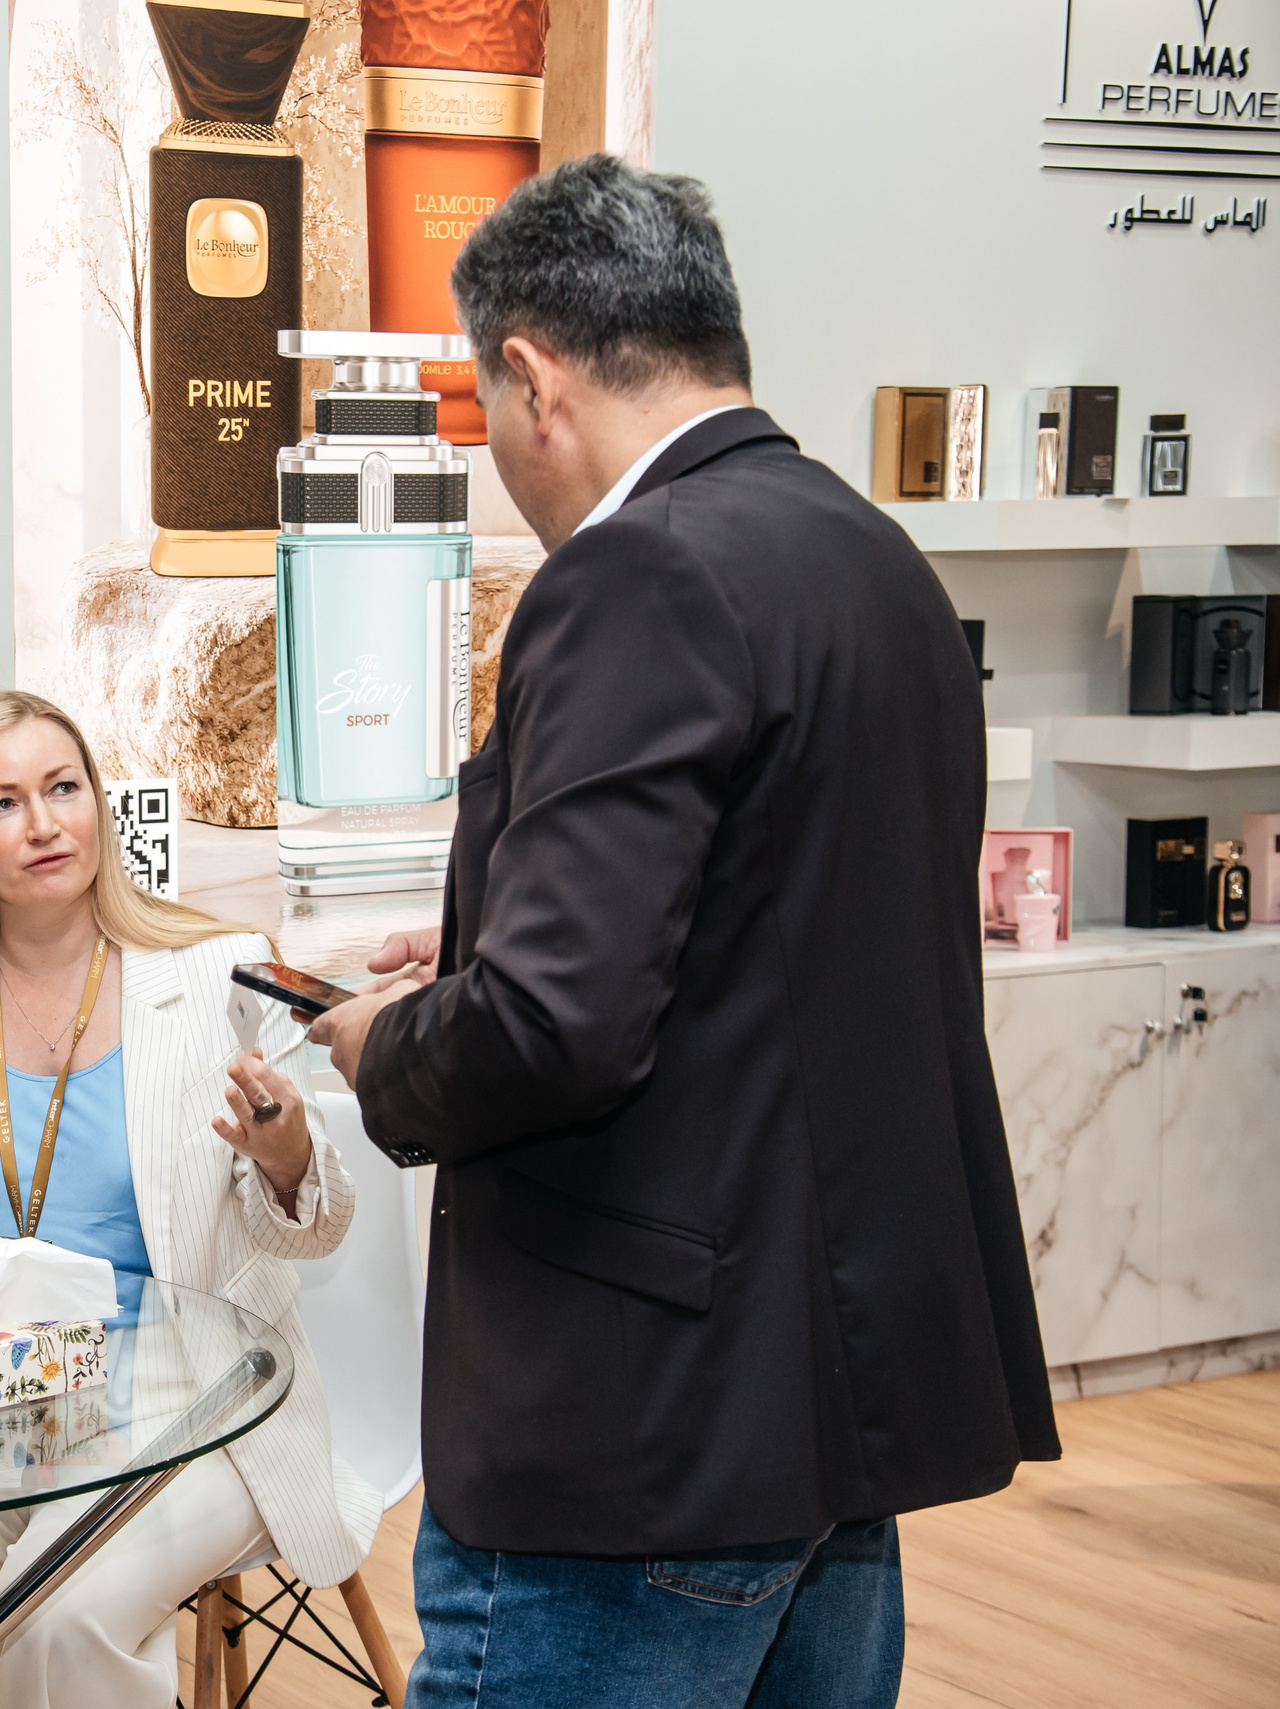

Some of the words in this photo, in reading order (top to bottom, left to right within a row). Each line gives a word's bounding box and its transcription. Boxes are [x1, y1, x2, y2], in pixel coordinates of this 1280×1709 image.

[1153, 43, 1250, 79] ALMAS
[399, 90, 423, 111] Le
[425, 91, 508, 125] Bonheur
[400, 114, 469, 125] PERFUMES
[414, 194, 496, 215] L'AMOUR
[1108, 194, 1194, 231] للعطور
[1204, 196, 1267, 233] الماس
[423, 220, 480, 240] ROUG
[197, 239, 209, 250] Le
[211, 239, 259, 258] Bonheur
[188, 379, 272, 408] PRIME
[460, 611, 470, 637] Le
[315, 668, 413, 719] Story
[453, 643, 470, 743] Bonheur
[346, 713, 390, 727] SPORT
[341, 807, 362, 817] EAU
[364, 805, 378, 815] DE
[380, 803, 421, 814] PARFUM
[341, 819, 387, 830] NATURAL
[0, 1099, 11, 1144] GELTEK
[28, 1189, 42, 1233] GELTEK
